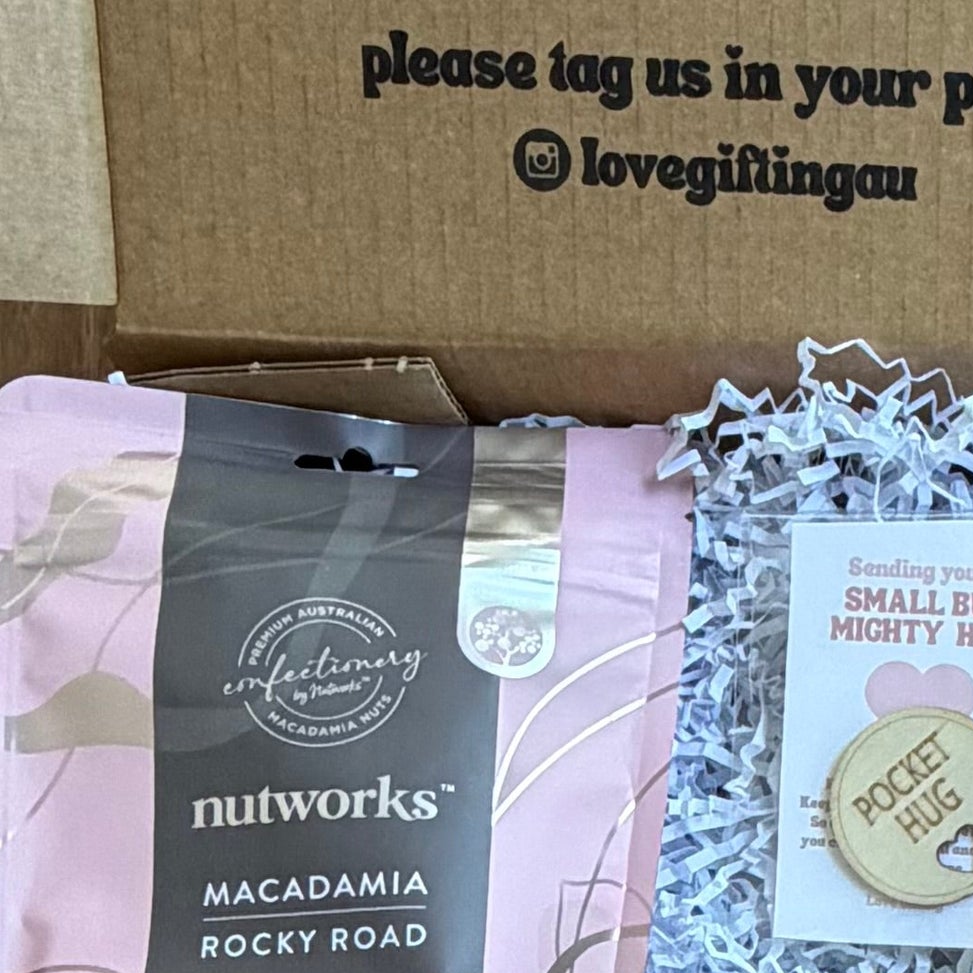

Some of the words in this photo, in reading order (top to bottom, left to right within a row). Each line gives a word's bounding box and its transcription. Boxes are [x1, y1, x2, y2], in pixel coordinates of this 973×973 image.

[361, 30, 538, 99] please
[548, 40, 634, 110] tag
[645, 56, 712, 98] us
[724, 44, 783, 101] in
[795, 64, 932, 119] your
[580, 136, 918, 212] lovegiftingau
[848, 556, 936, 585] Sending
[844, 586, 945, 615] SMALL
[248, 613, 294, 666] PREMIUM
[297, 605, 385, 638] AUSTRALIAN
[830, 615, 944, 645] MIGHTY
[222, 646, 428, 702] confectionery
[268, 710, 358, 737] MACADAMIA
[359, 694, 393, 725] NUTS
[852, 731, 950, 826] POCKET
[894, 777, 963, 844] HUG
[800, 837, 826, 849] you
[203, 870, 428, 907] MACADAMIA
[200, 929, 317, 959] ROCKY
[331, 923, 427, 951] ROAD
